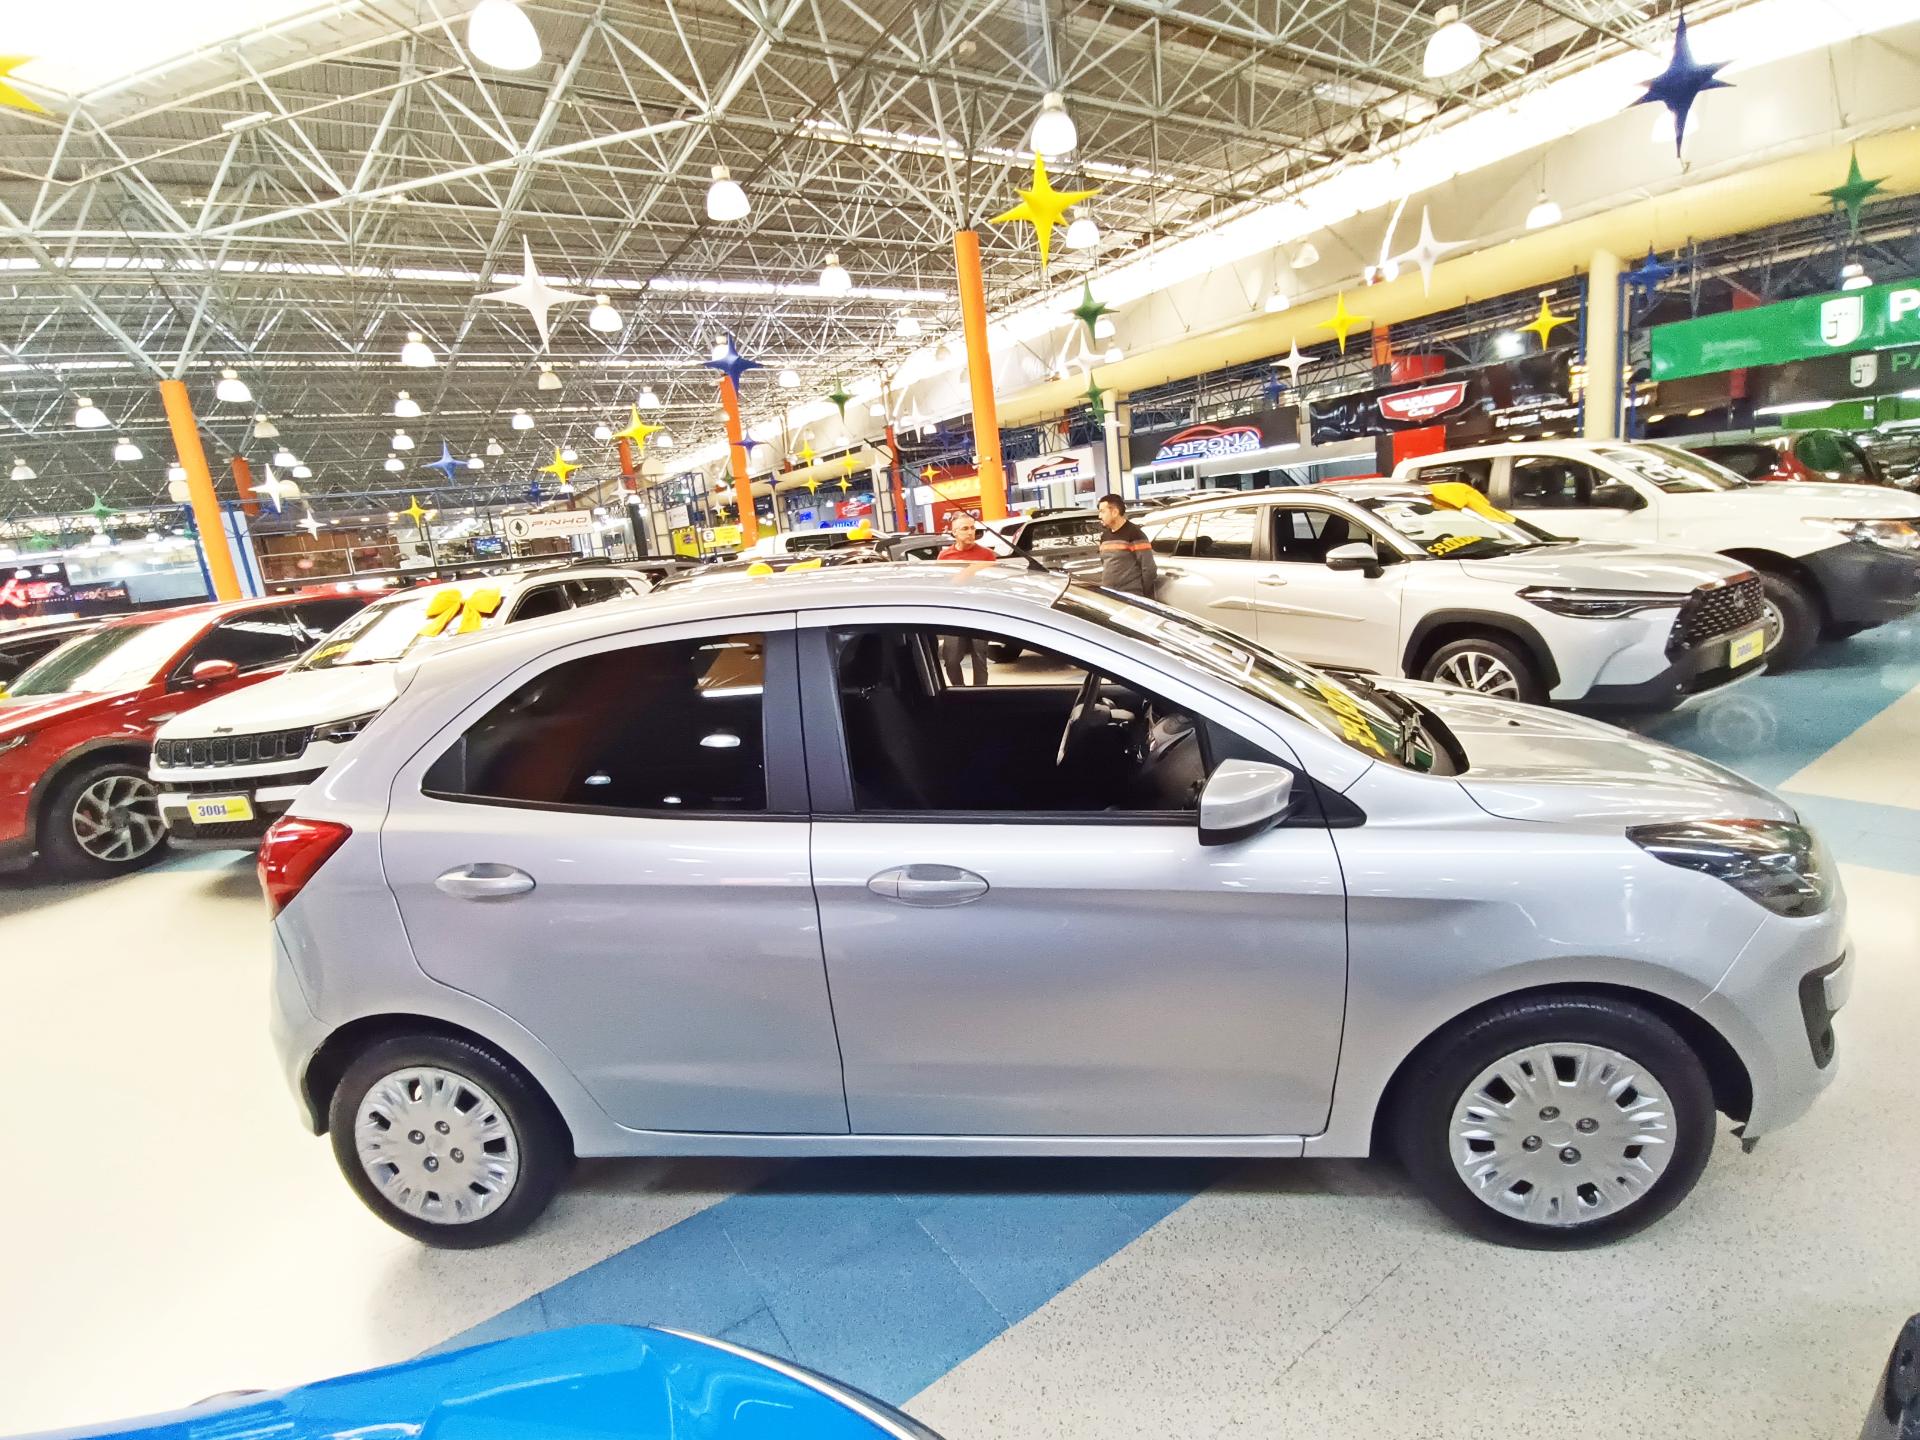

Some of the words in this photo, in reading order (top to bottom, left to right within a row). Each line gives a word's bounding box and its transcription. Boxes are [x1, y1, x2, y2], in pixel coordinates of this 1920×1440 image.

[1889, 289, 1920, 322] P
[1156, 431, 1260, 460] ARIZONA
[531, 517, 588, 528] PINHO
[198, 804, 227, 817] 3001
